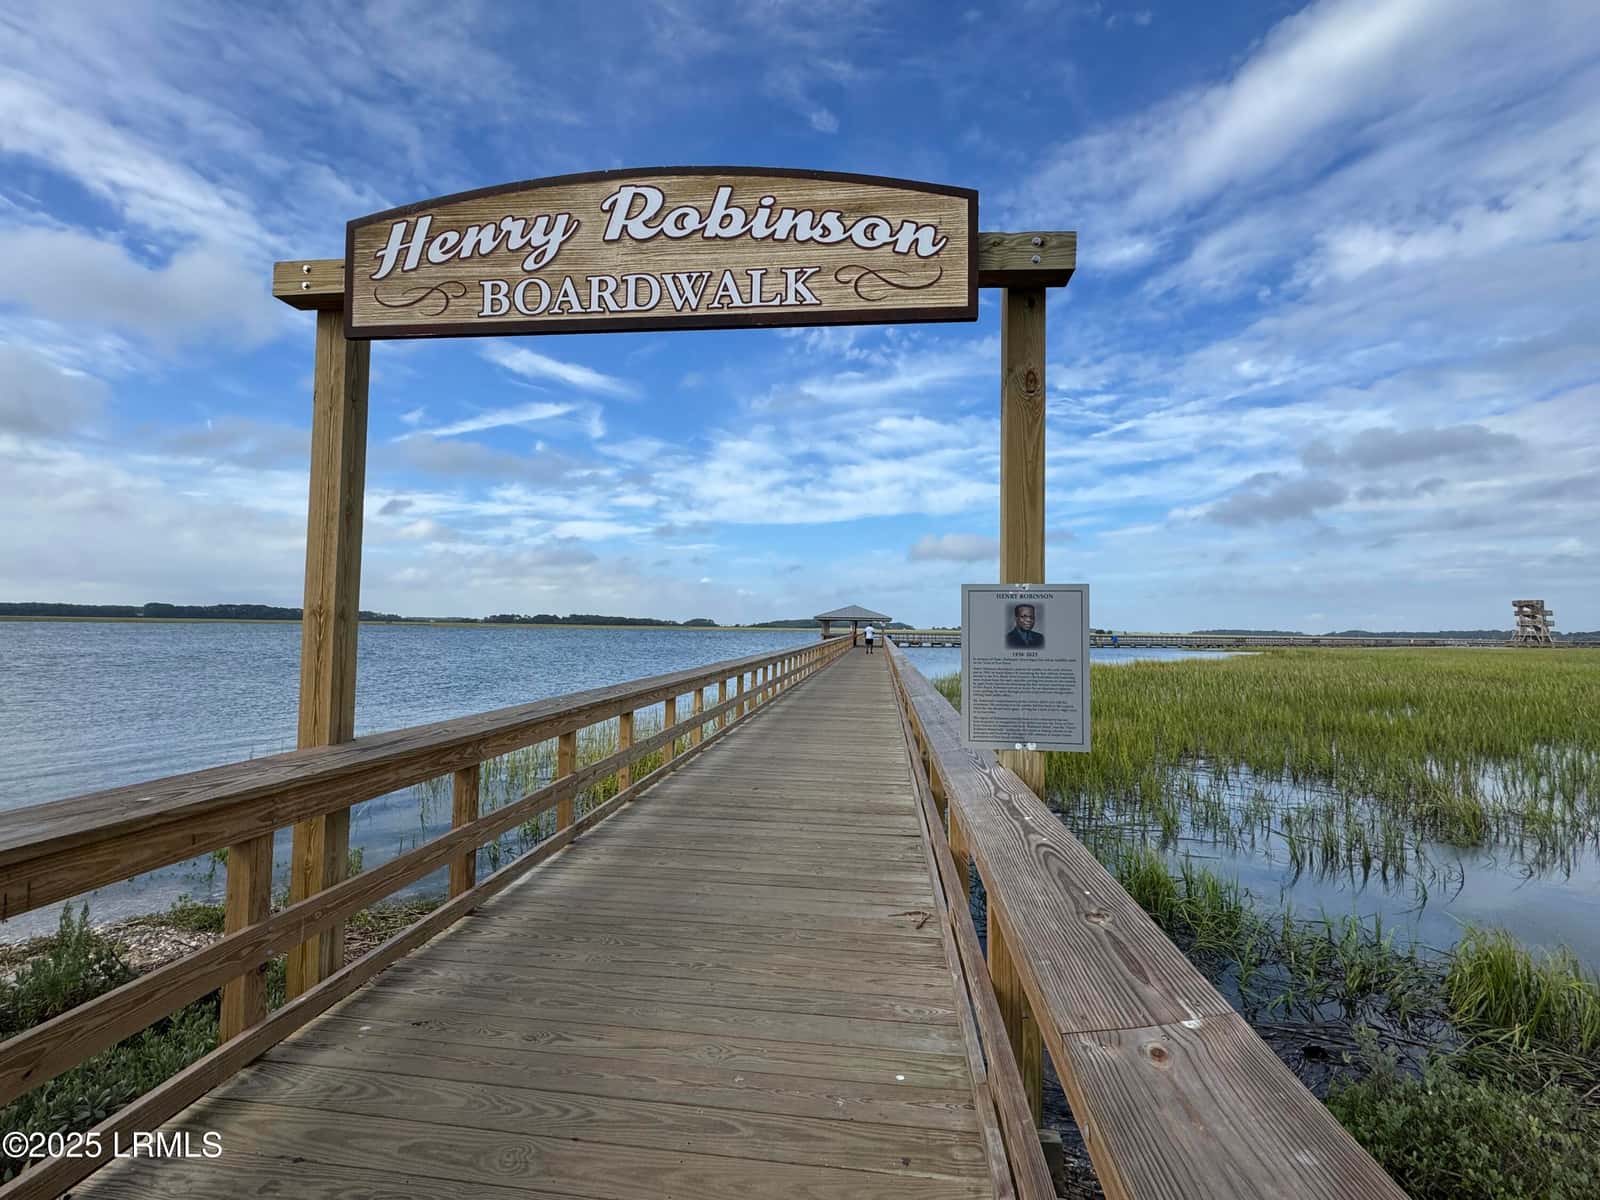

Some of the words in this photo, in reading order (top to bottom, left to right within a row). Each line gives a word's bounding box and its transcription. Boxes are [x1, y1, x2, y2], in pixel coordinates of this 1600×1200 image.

[370, 212, 580, 280] Henry
[601, 184, 948, 258] Robinson
[478, 267, 821, 318] BOARDWALK
[995, 592, 1018, 600] HENRY
[1020, 592, 1054, 600] ROBINSON
